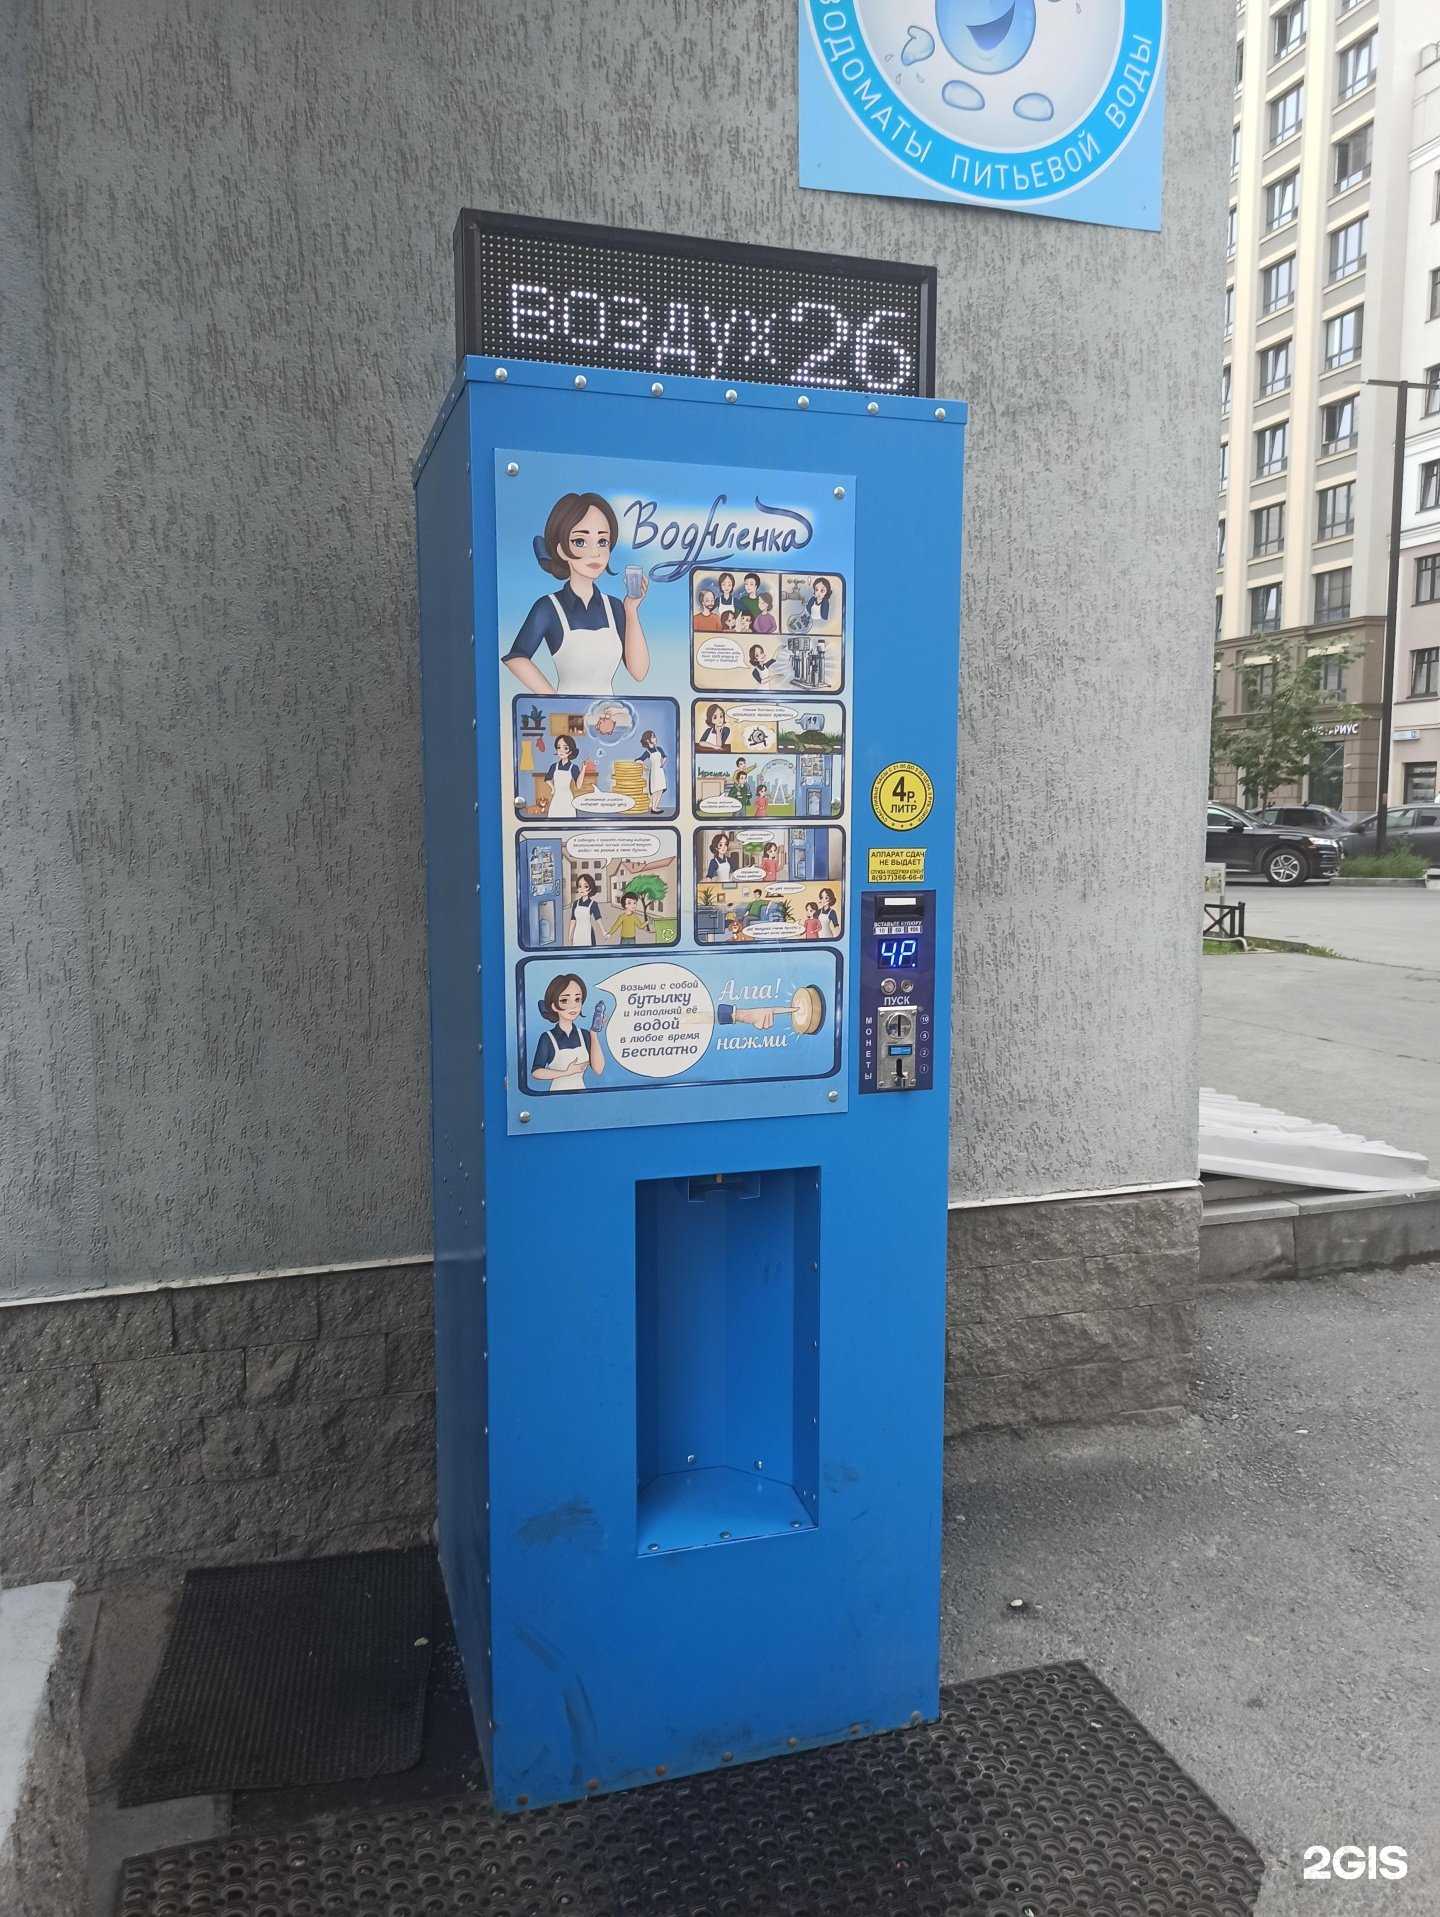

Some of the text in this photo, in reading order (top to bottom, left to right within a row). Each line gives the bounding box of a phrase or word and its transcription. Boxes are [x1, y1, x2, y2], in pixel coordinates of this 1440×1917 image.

[819, 0, 1153, 191] ОДОМАТЫ ПИТЬЕВОЙ ВОДЫ
[790, 300, 912, 391] 26
[890, 804, 918, 814] ЛИТР
[670, 980, 699, 990] собой
[718, 978, 782, 1001] Алга!
[628, 992, 692, 1008] бутылку
[883, 996, 910, 1006] ПУСК
[633, 1006, 683, 1017] наполняй
[633, 1016, 680, 1032] водой
[630, 1034, 664, 1044] любое
[668, 1032, 700, 1043] время
[716, 1034, 789, 1051] нажми
[621, 1045, 698, 1058] Бесплатно
